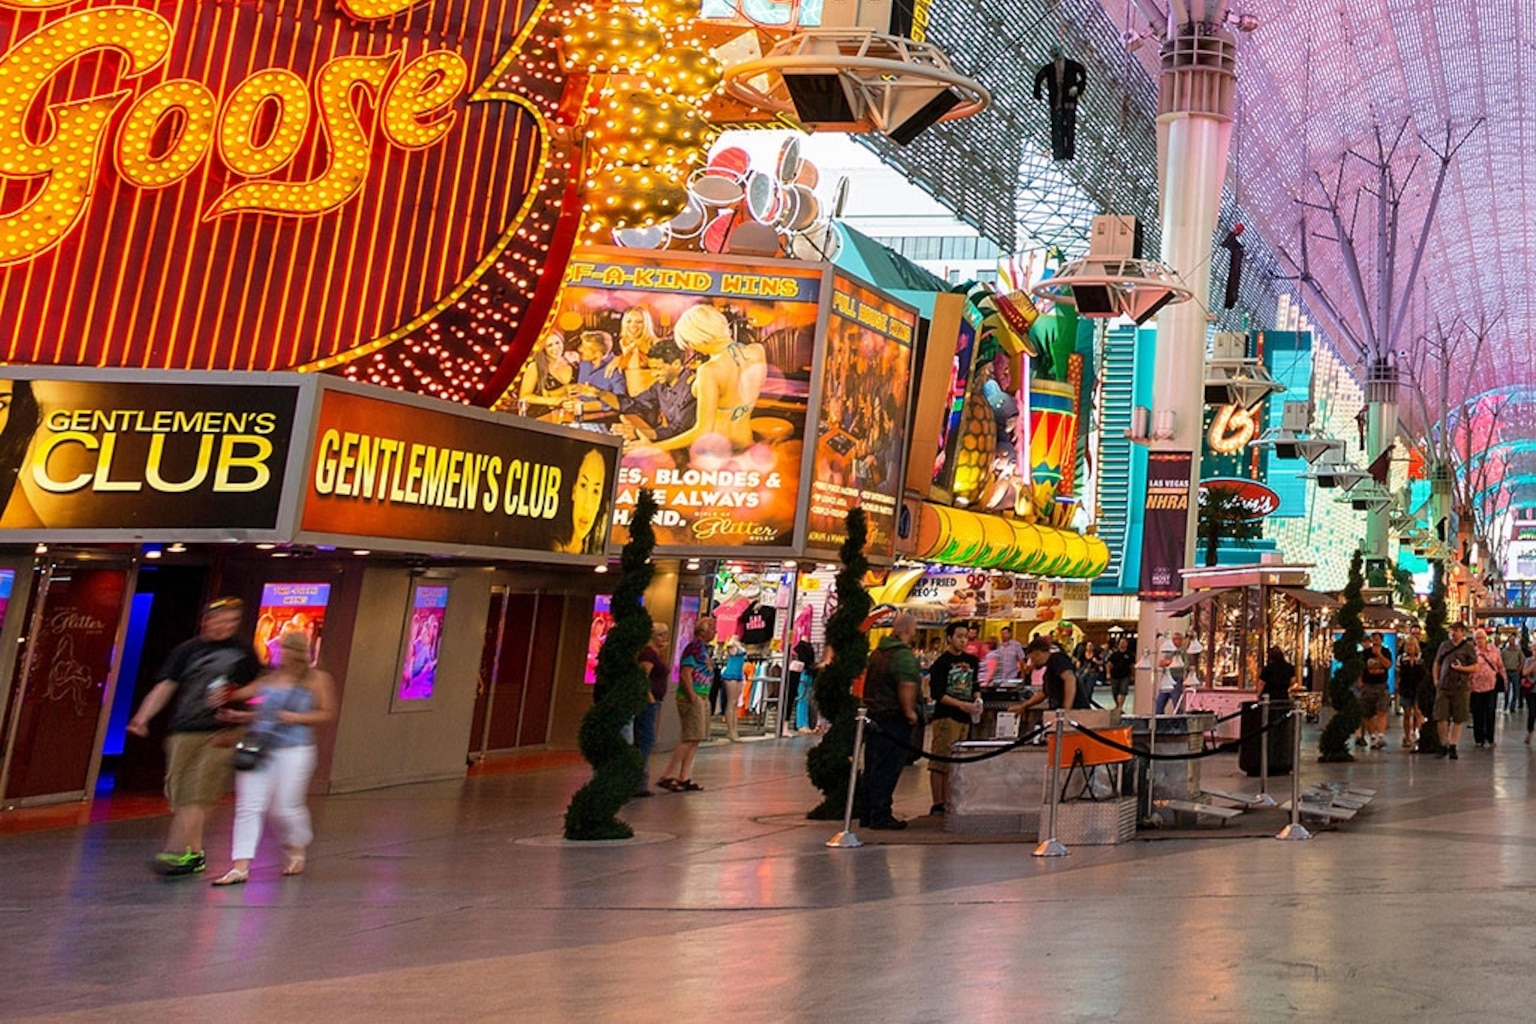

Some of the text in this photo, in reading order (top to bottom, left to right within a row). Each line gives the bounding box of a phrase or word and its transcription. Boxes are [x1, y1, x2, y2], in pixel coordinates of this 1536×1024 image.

[0, 6, 468, 267] Goose
[567, 262, 799, 297] F-A-KIND WINS
[46, 409, 277, 434] GENTLEMEN'S
[31, 433, 273, 493] CLUB
[314, 428, 560, 519] GENTLEMEN'S CLUB
[655, 469, 760, 488] BLONDES
[765, 472, 782, 489] &
[1149, 479, 1189, 488] LAS VEGAS
[615, 489, 760, 508] AE ALWAYS
[1145, 494, 1187, 510] NHRA
[612, 509, 687, 527] HND.
[691, 516, 778, 540] Glitter
[911, 586, 938, 597] REO'S
[931, 578, 957, 588] FRIED
